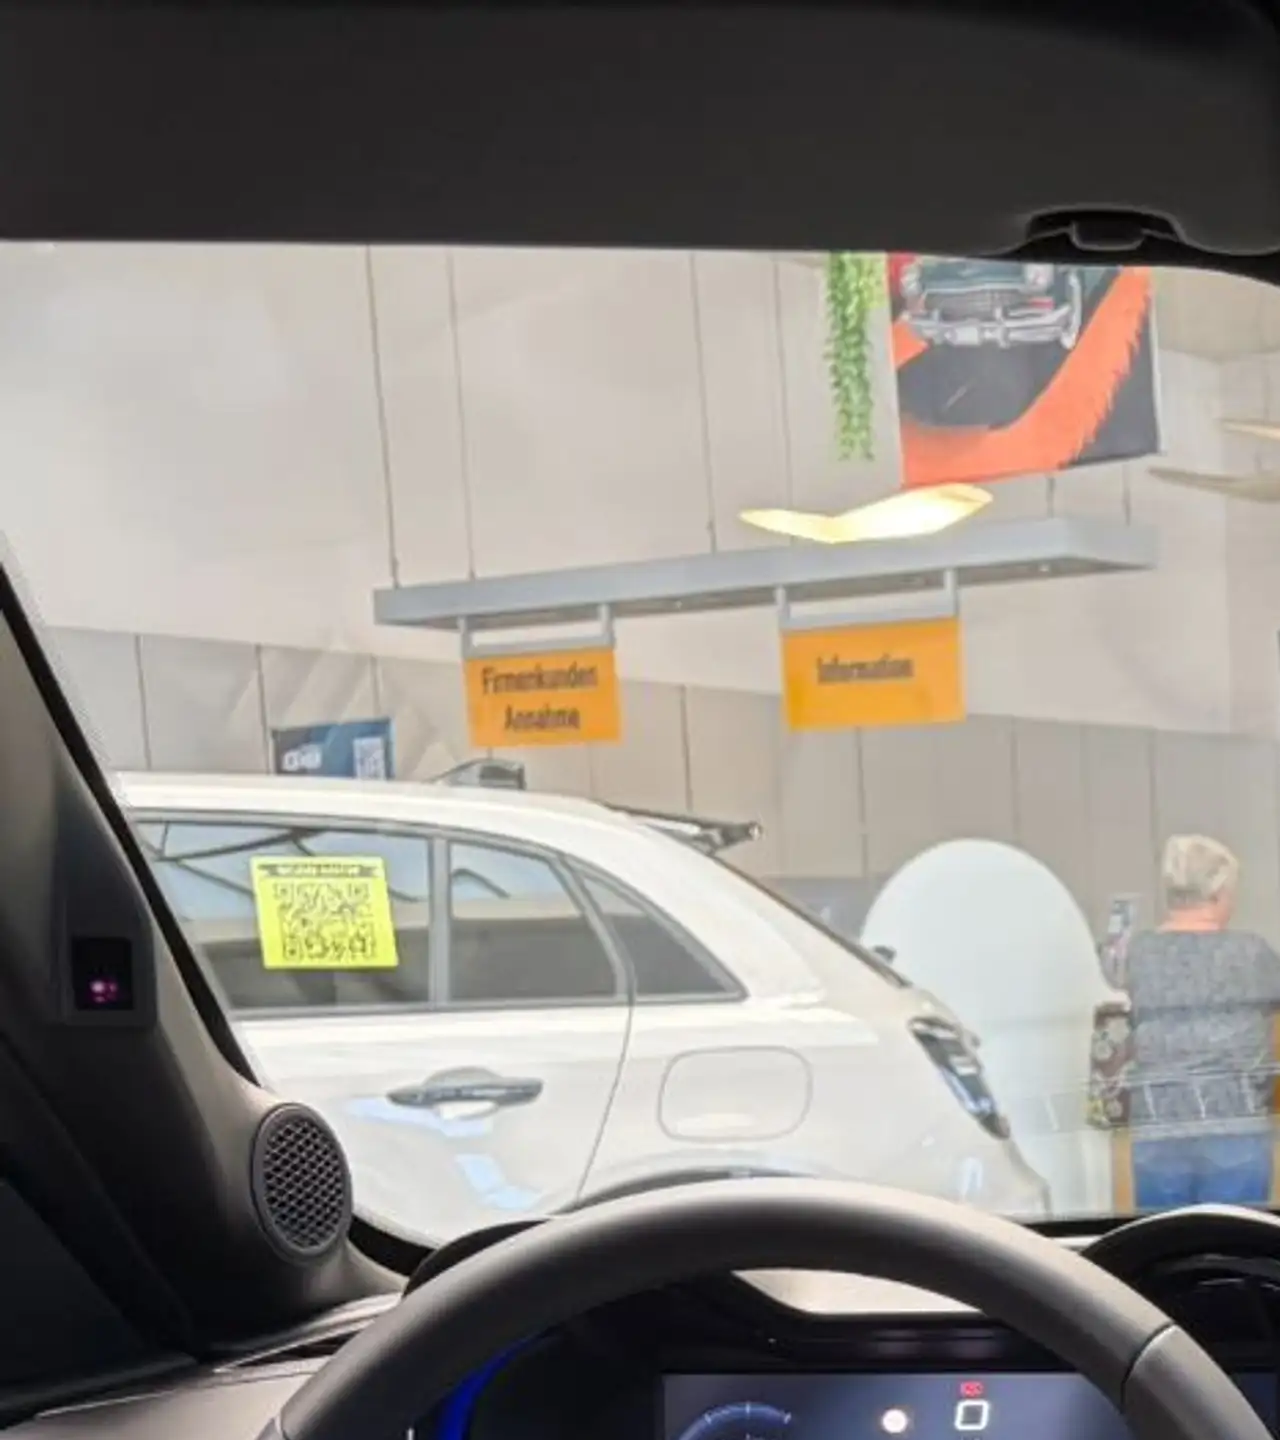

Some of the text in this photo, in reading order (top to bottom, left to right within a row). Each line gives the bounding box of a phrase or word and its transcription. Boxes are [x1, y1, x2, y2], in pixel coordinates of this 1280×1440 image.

[481, 662, 598, 695] Firmenkunden
[817, 655, 914, 686] Information
[504, 704, 580, 732] Annahme
[954, 1399, 989, 1431] 0
